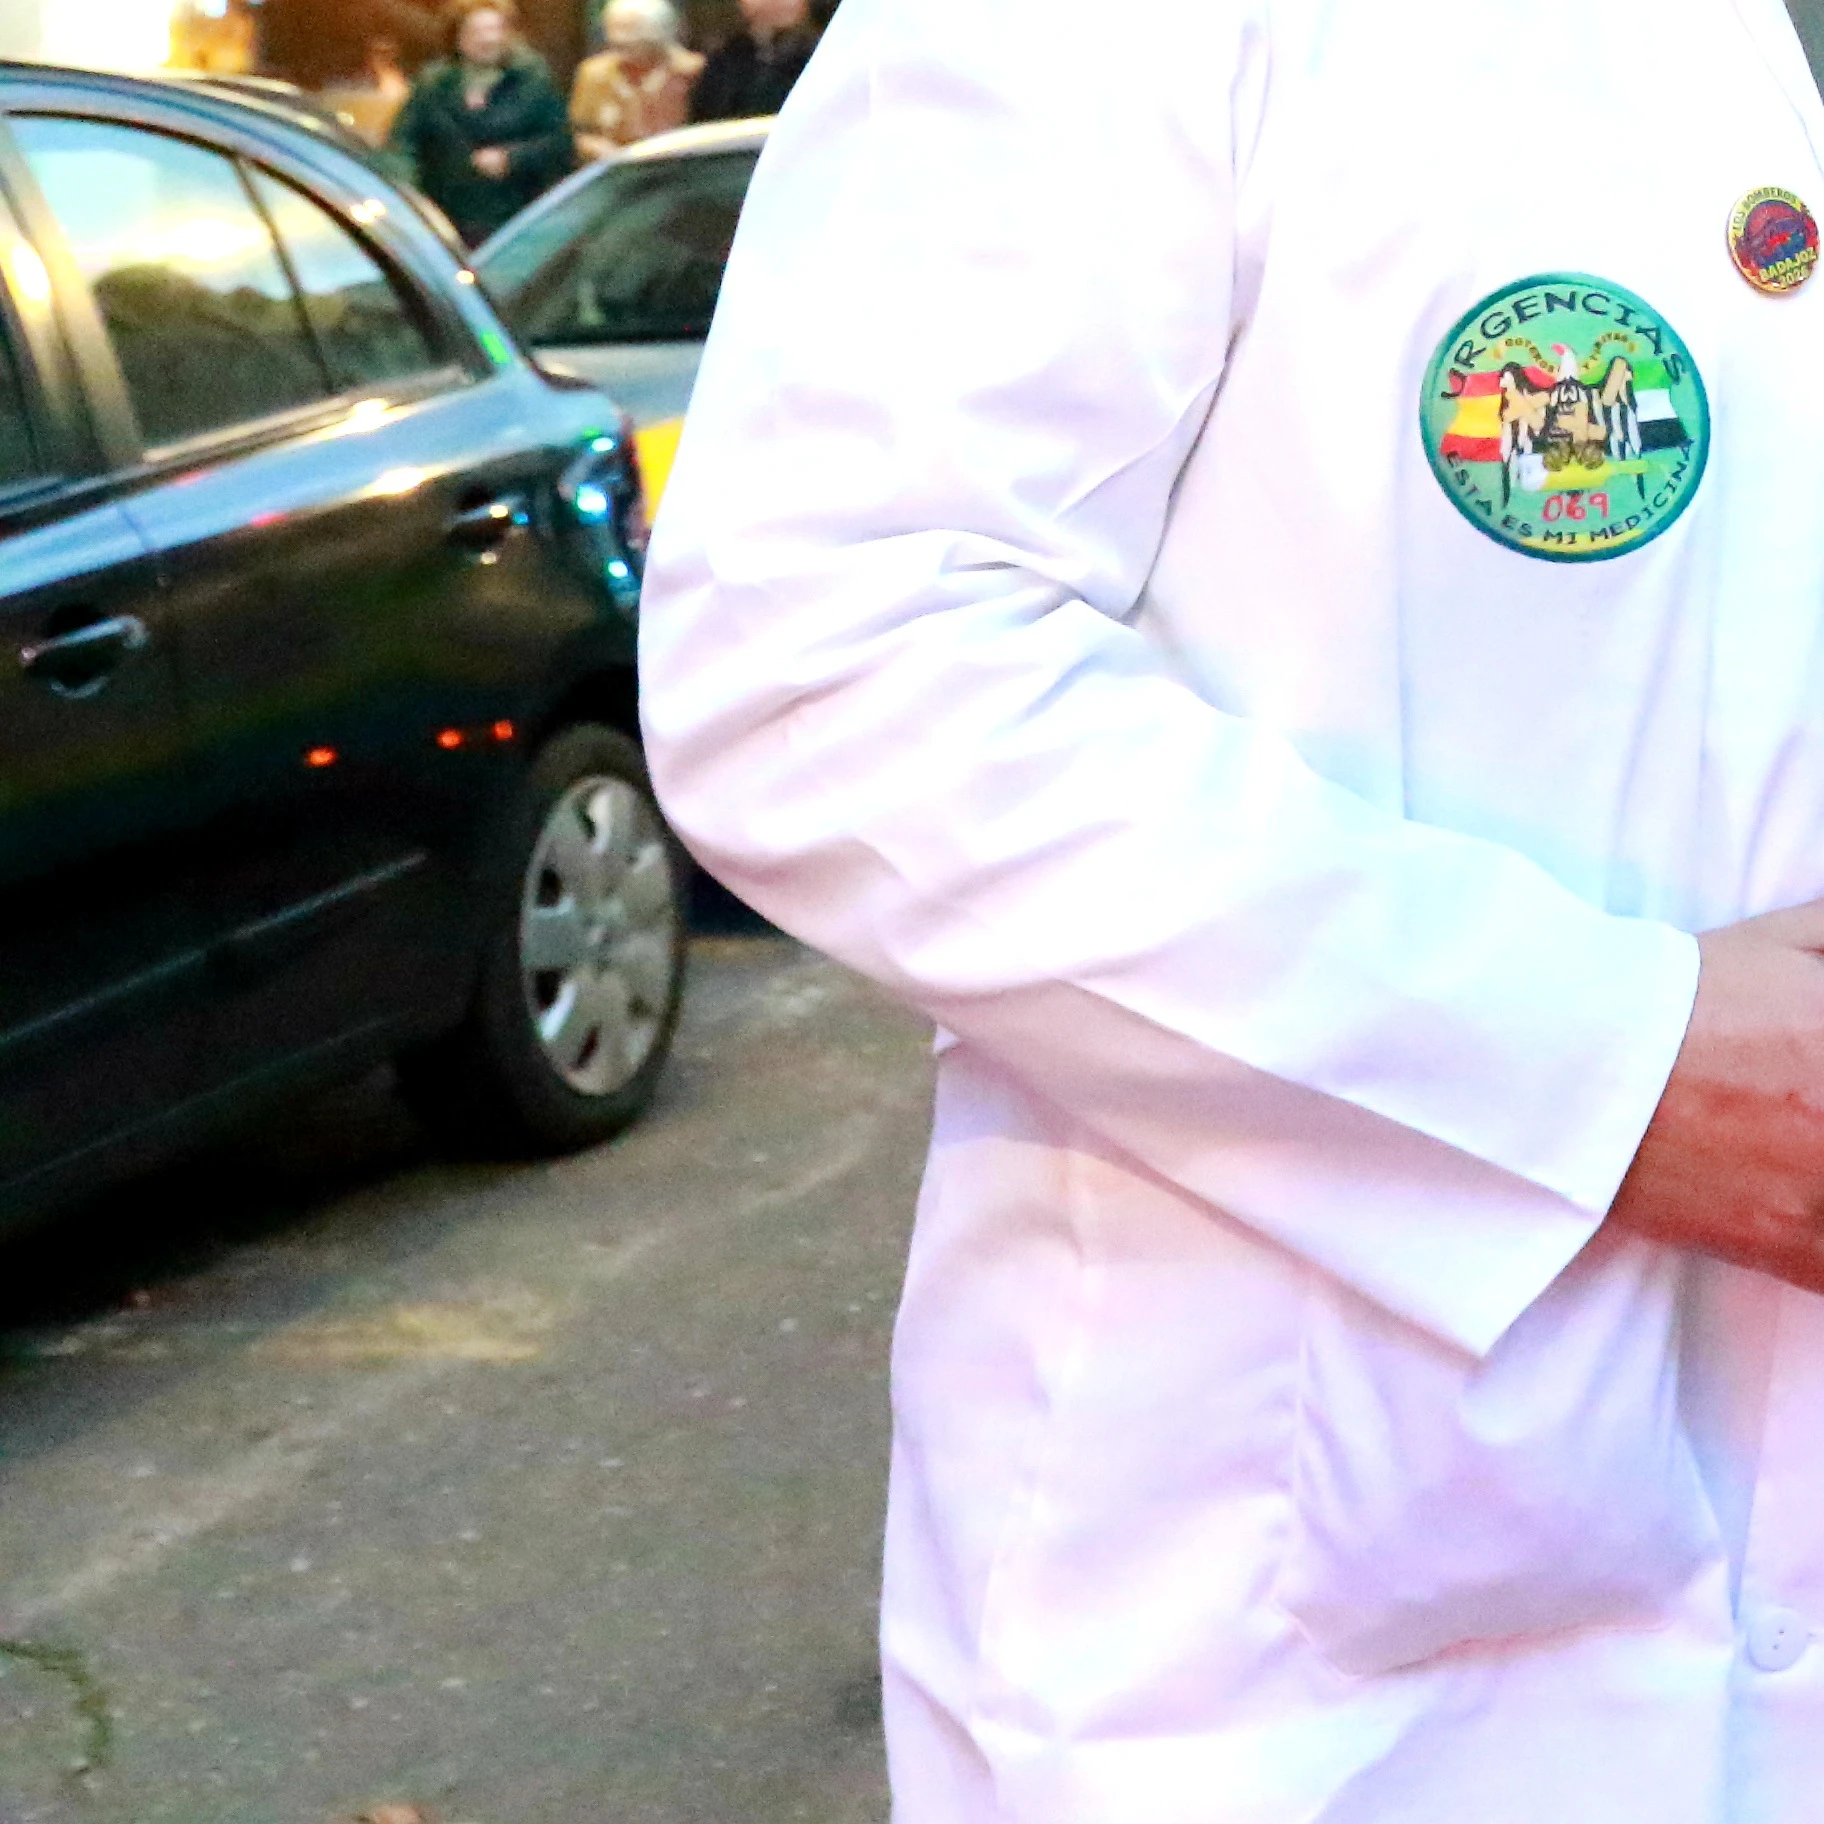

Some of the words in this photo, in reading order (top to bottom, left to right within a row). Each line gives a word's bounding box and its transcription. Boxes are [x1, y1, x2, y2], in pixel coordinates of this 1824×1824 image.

[1759, 247, 1817, 282] BADAJOZ
[1441, 290, 1687, 399] URGENCIAS
[1446, 450, 1493, 517] ESTA
[1501, 514, 1534, 539] ES
[1543, 529, 1578, 545] MI
[1590, 438, 1695, 543] MEDICINA
